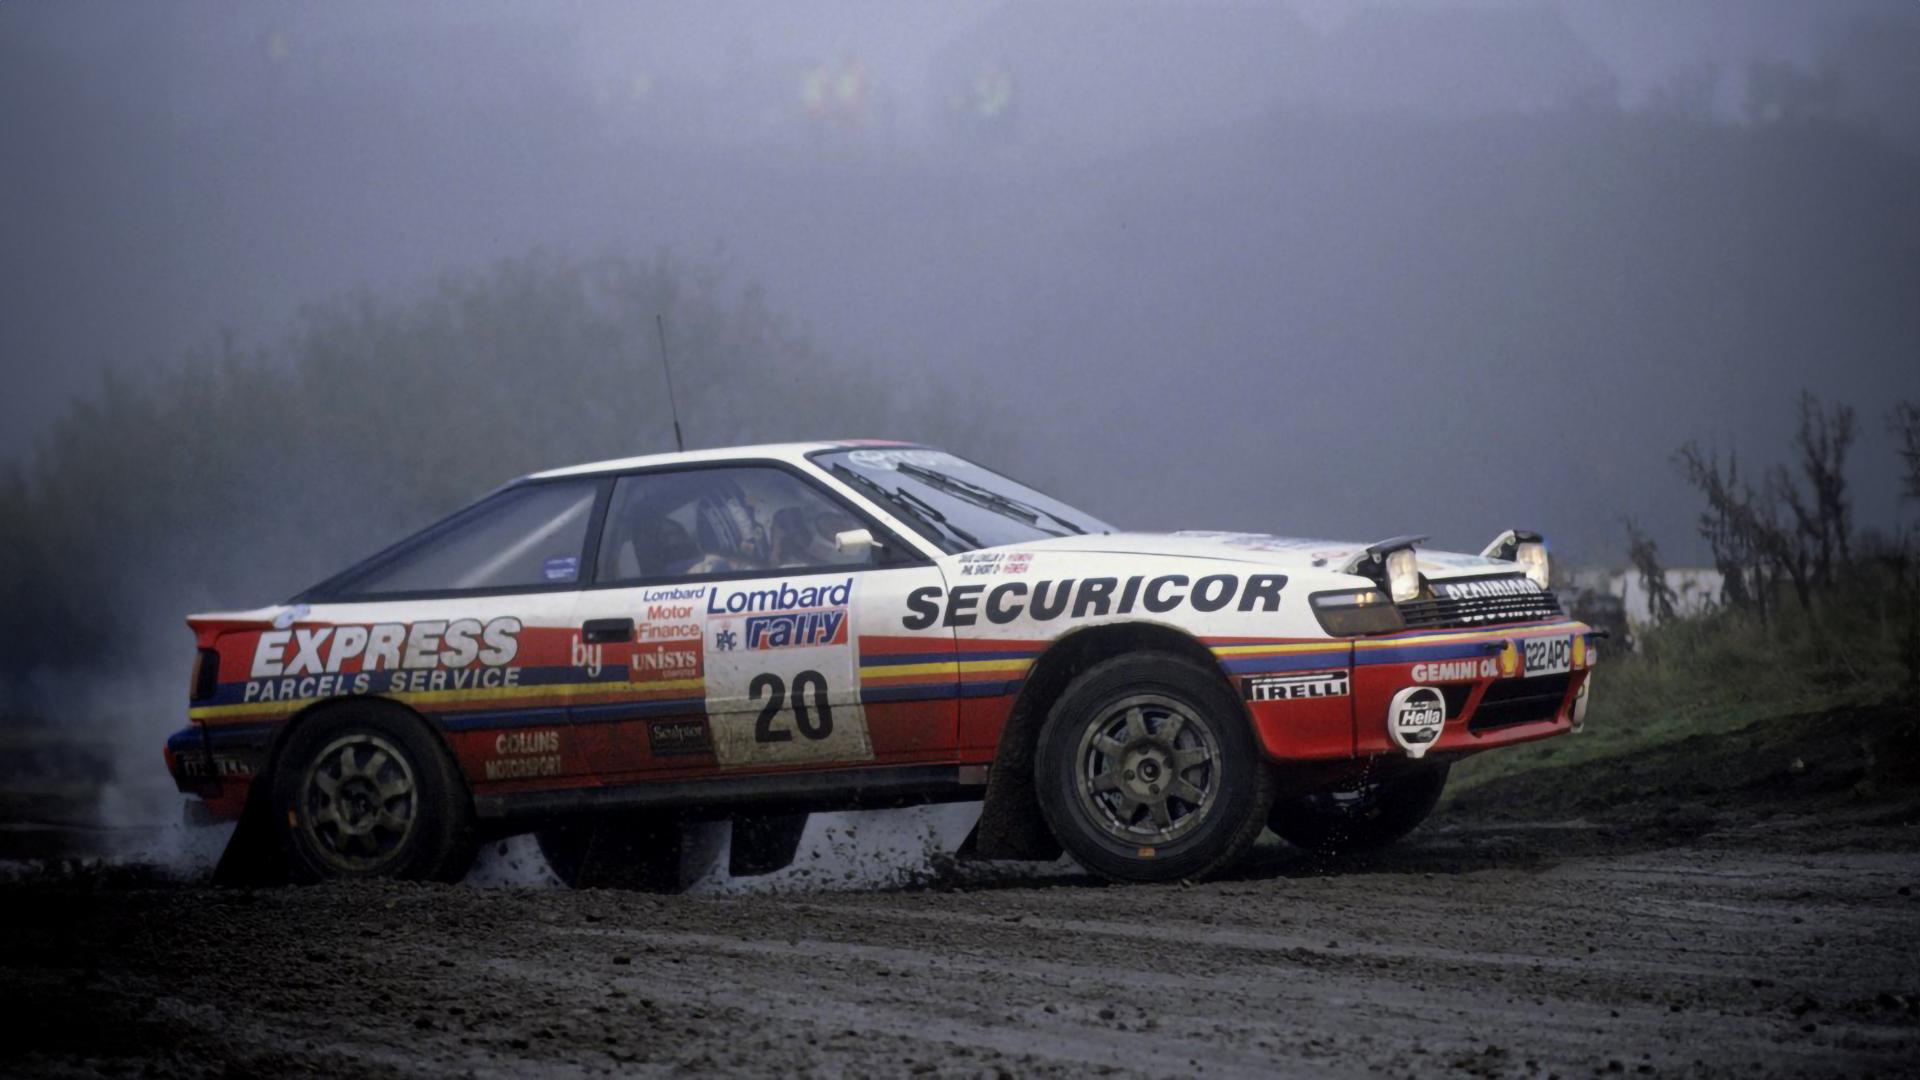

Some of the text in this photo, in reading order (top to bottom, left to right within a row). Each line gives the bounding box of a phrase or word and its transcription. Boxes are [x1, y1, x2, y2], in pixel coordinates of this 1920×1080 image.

[643, 586, 707, 603] Lombard
[707, 577, 853, 615] Lombard
[902, 574, 1288, 631] SECURICOR
[647, 605, 693, 620] Motor
[639, 622, 700, 640] Finance
[716, 629, 737, 651] RAC
[750, 610, 845, 649] rally
[250, 616, 523, 678] EXPRESS
[571, 634, 602, 678] by
[244, 666, 522, 703] PARCELS SERVICE
[1242, 669, 1350, 700] PIRELLI
[1411, 659, 1499, 682] GEMINI OIL
[748, 669, 834, 743] 20
[1401, 709, 1440, 725] Hella
[495, 731, 559, 755] COLLINS
